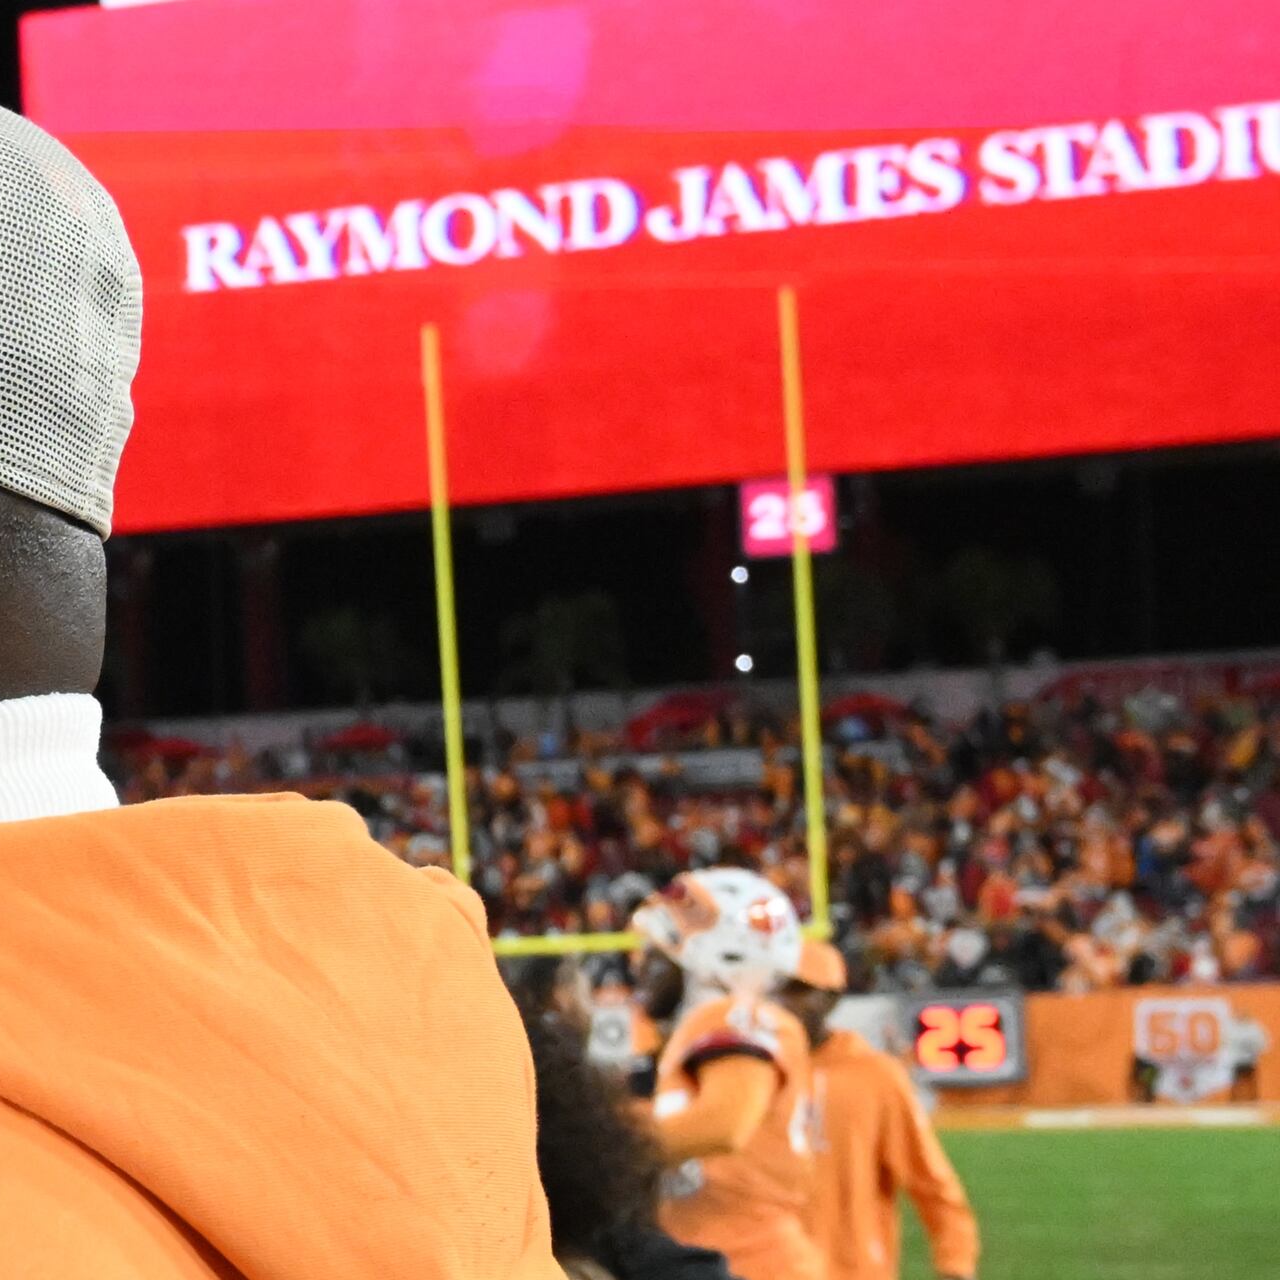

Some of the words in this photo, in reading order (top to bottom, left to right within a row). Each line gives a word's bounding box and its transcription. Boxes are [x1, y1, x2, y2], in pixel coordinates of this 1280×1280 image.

[183, 180, 640, 293] RAYMOND
[645, 138, 967, 242] JAMES
[916, 1004, 1007, 1073] 25
